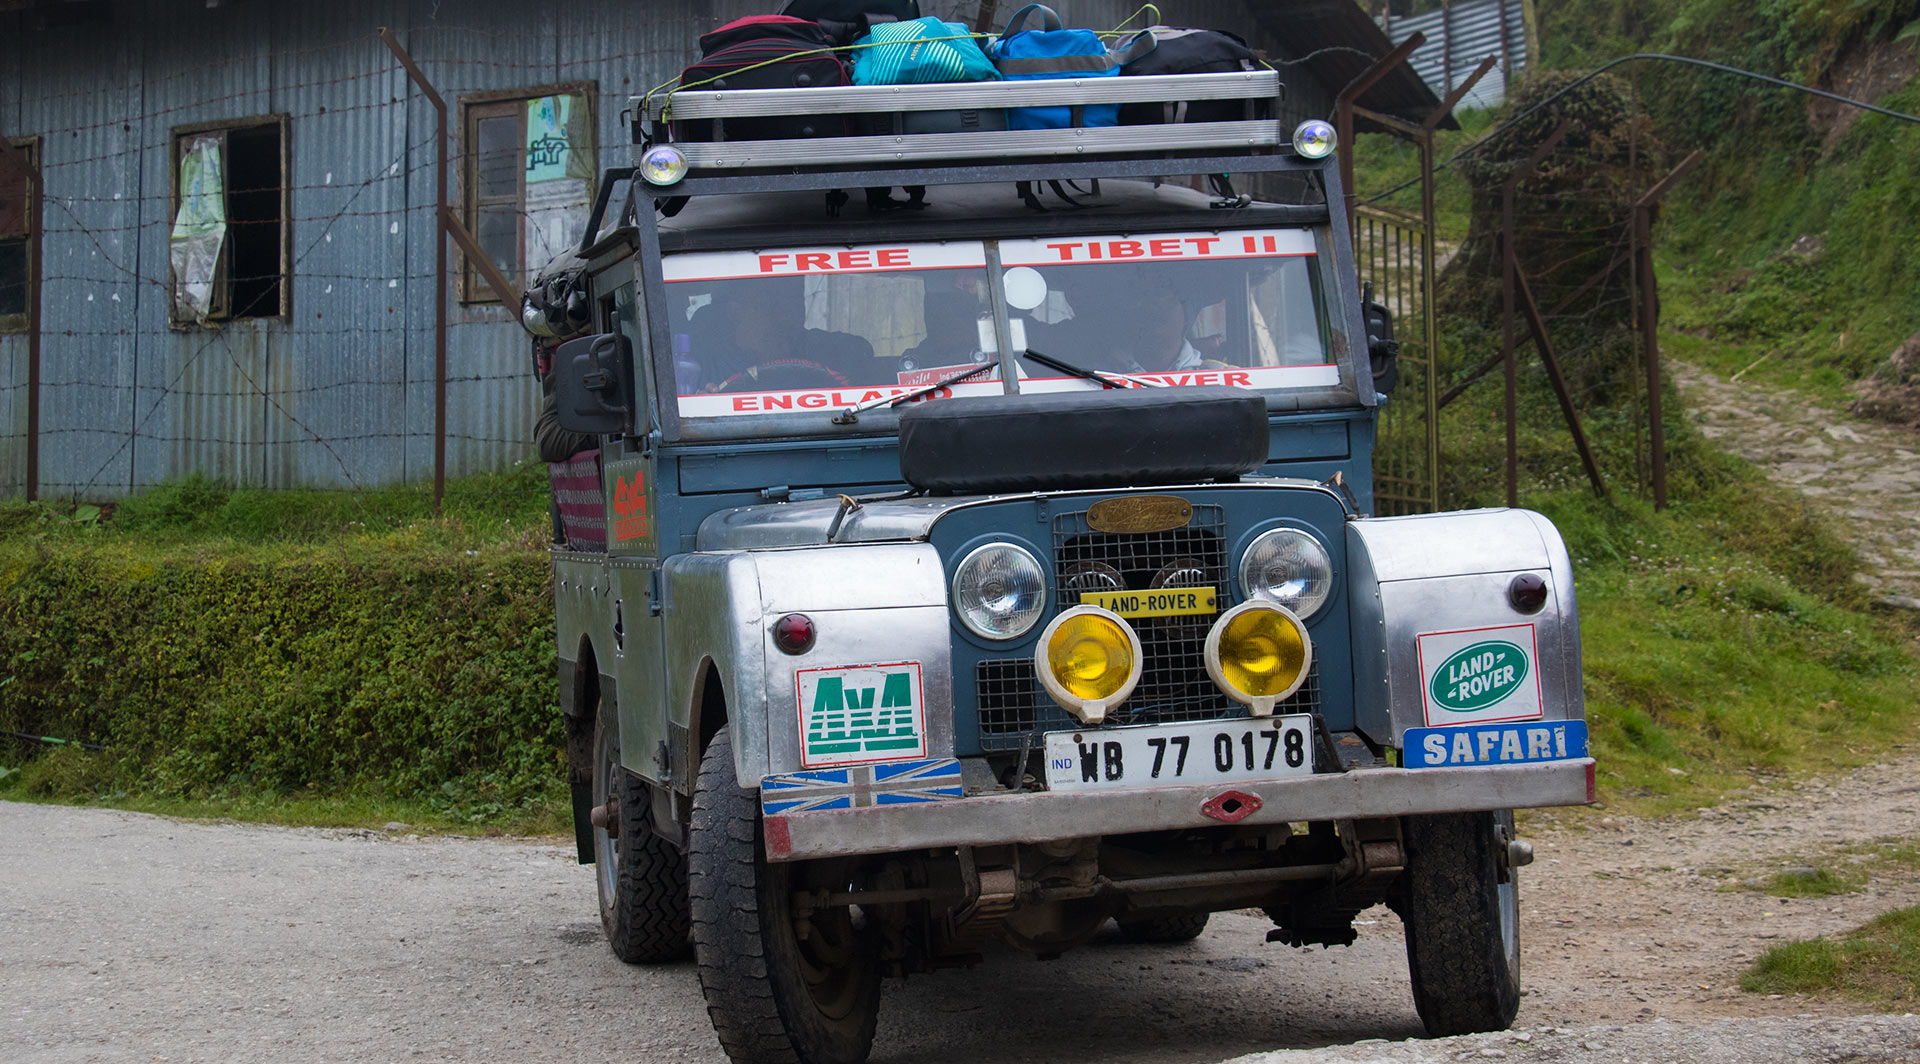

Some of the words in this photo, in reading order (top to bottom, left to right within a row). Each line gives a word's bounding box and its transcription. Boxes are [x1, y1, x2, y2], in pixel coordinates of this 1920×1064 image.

[758, 248, 912, 273] FREE
[1046, 237, 1220, 261] TIBET
[1242, 235, 1277, 254] II
[1051, 758, 1073, 770] IND
[1078, 741, 1124, 783] WB
[1147, 735, 1190, 779] 77
[1214, 728, 1305, 773] 0178
